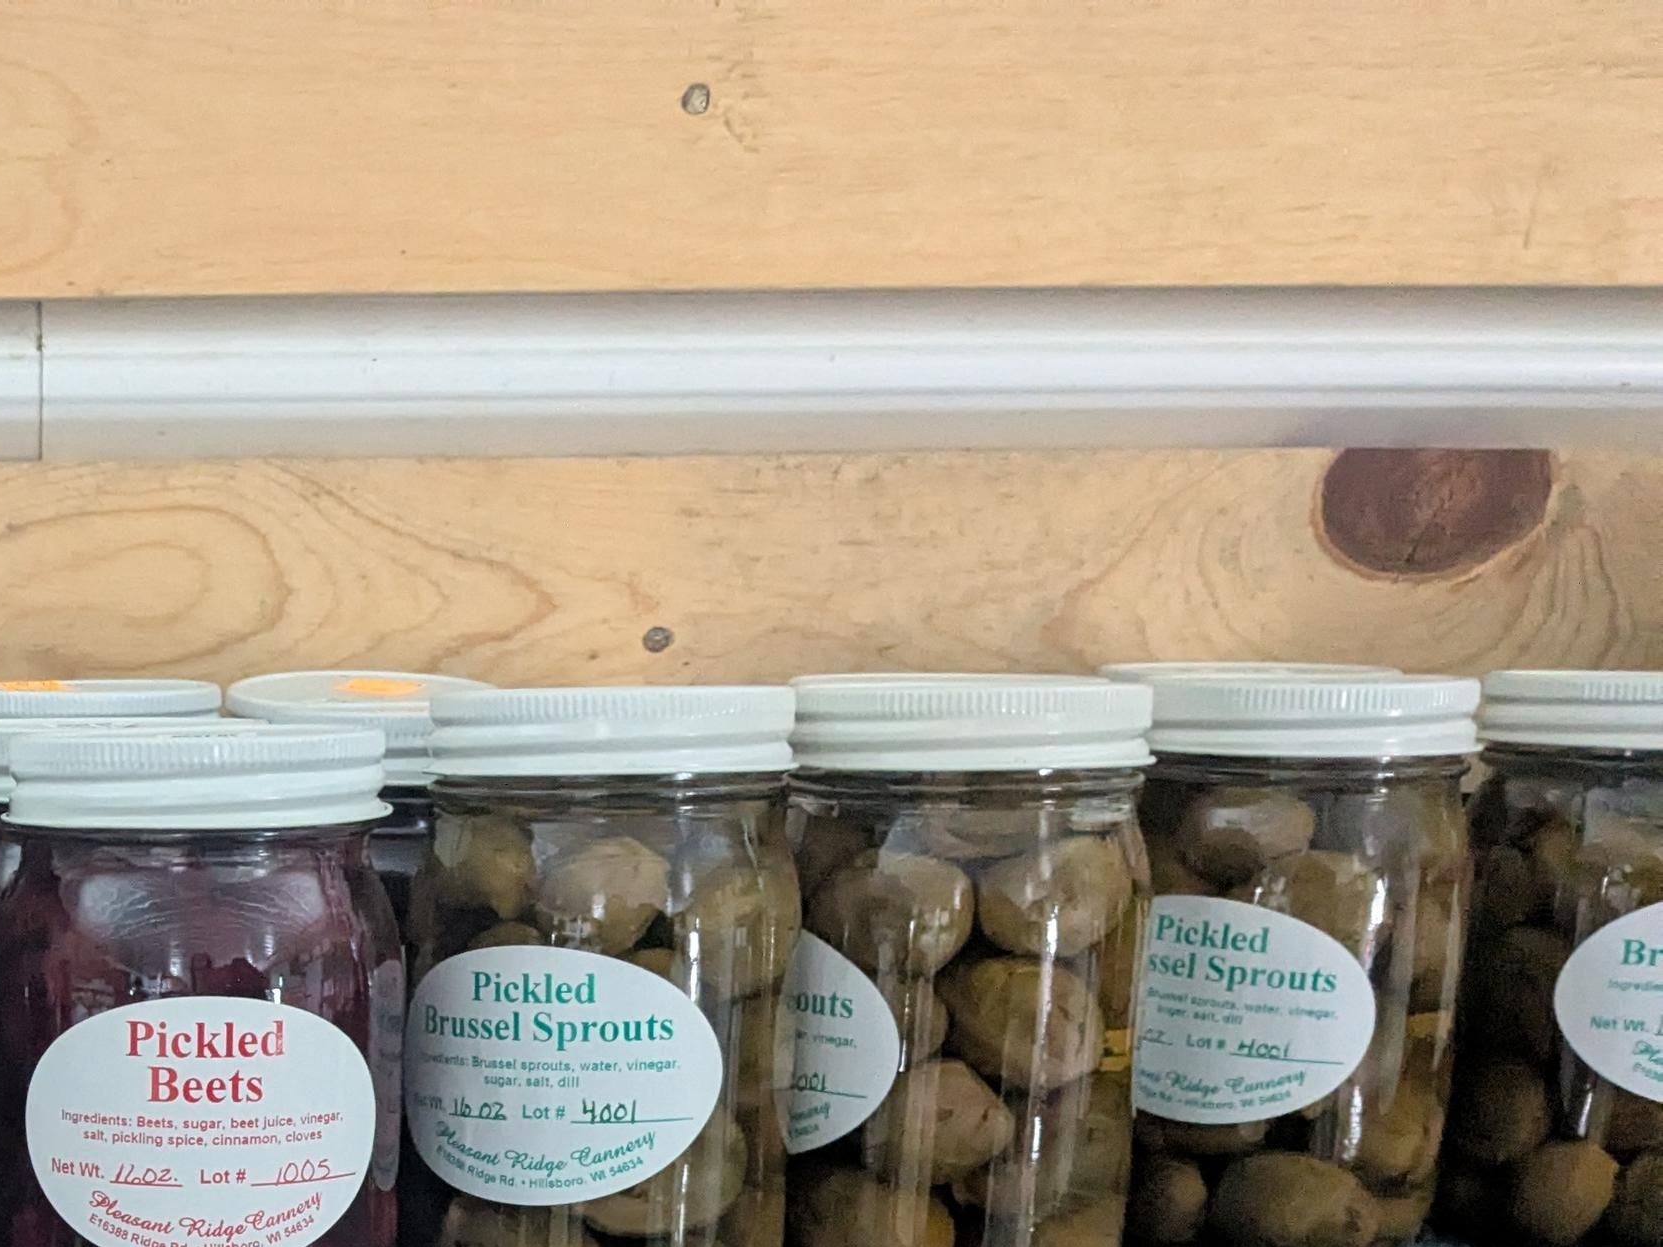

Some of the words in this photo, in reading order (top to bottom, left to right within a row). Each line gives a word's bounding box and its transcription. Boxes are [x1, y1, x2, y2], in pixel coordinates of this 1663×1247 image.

[1156, 913, 1270, 954] Pickled
[472, 971, 596, 1004] Pickled
[1148, 953, 1197, 979] ssel
[1205, 955, 1337, 993] Sprouts
[790, 991, 853, 1019] outs
[425, 1005, 520, 1042] Brussel
[533, 1011, 674, 1051] Sprouts
[1590, 1016, 1617, 1031] Net
[125, 1019, 286, 1059] Pickled
[1187, 1034, 1211, 1049] Lot
[472, 1055, 516, 1070] Brussel
[521, 1059, 574, 1073] sprouts,
[580, 1060, 621, 1073] water,
[147, 1066, 264, 1103] Beets
[484, 1074, 521, 1088] sugar,
[526, 1076, 553, 1089] salt,
[558, 1075, 580, 1088] dill
[1165, 1071, 1220, 1098] Ridge
[1225, 1069, 1307, 1094] Cannery
[62, 1109, 132, 1128] Ingredients:
[137, 1116, 178, 1131] Beets,
[183, 1117, 225, 1132] sugar,
[230, 1116, 258, 1129] beet
[261, 1114, 297, 1130] juice,
[300, 1110, 343, 1127] vinegar,
[522, 1104, 550, 1119] Lot
[555, 1106, 566, 1119] #
[582, 1097, 636, 1125] 4001
[83, 1129, 107, 1142] salt,
[112, 1130, 163, 1147] pickling
[168, 1132, 207, 1148] spice,
[212, 1133, 281, 1146] cinnamon,
[286, 1129, 322, 1143] cloves
[436, 1121, 500, 1165] Pleasant
[505, 1150, 568, 1177] Ridge
[571, 1130, 656, 1166] Cannery
[51, 1157, 74, 1175] Net
[79, 1161, 105, 1179] Wt.
[200, 1169, 230, 1184] Lot
[236, 1170, 246, 1184] #
[276, 1159, 331, 1186] 1005
[467, 1164, 497, 1183] Ridge
[590, 1169, 608, 1182] WI
[610, 1157, 643, 1177] 54634
[89, 1190, 174, 1235] Pleasant
[179, 1217, 249, 1242] Ridge
[245, 1192, 323, 1230] Cannery
[89, 1212, 128, 1241] E16388
[267, 1229, 282, 1245] WI
[284, 1215, 315, 1238] 54634
